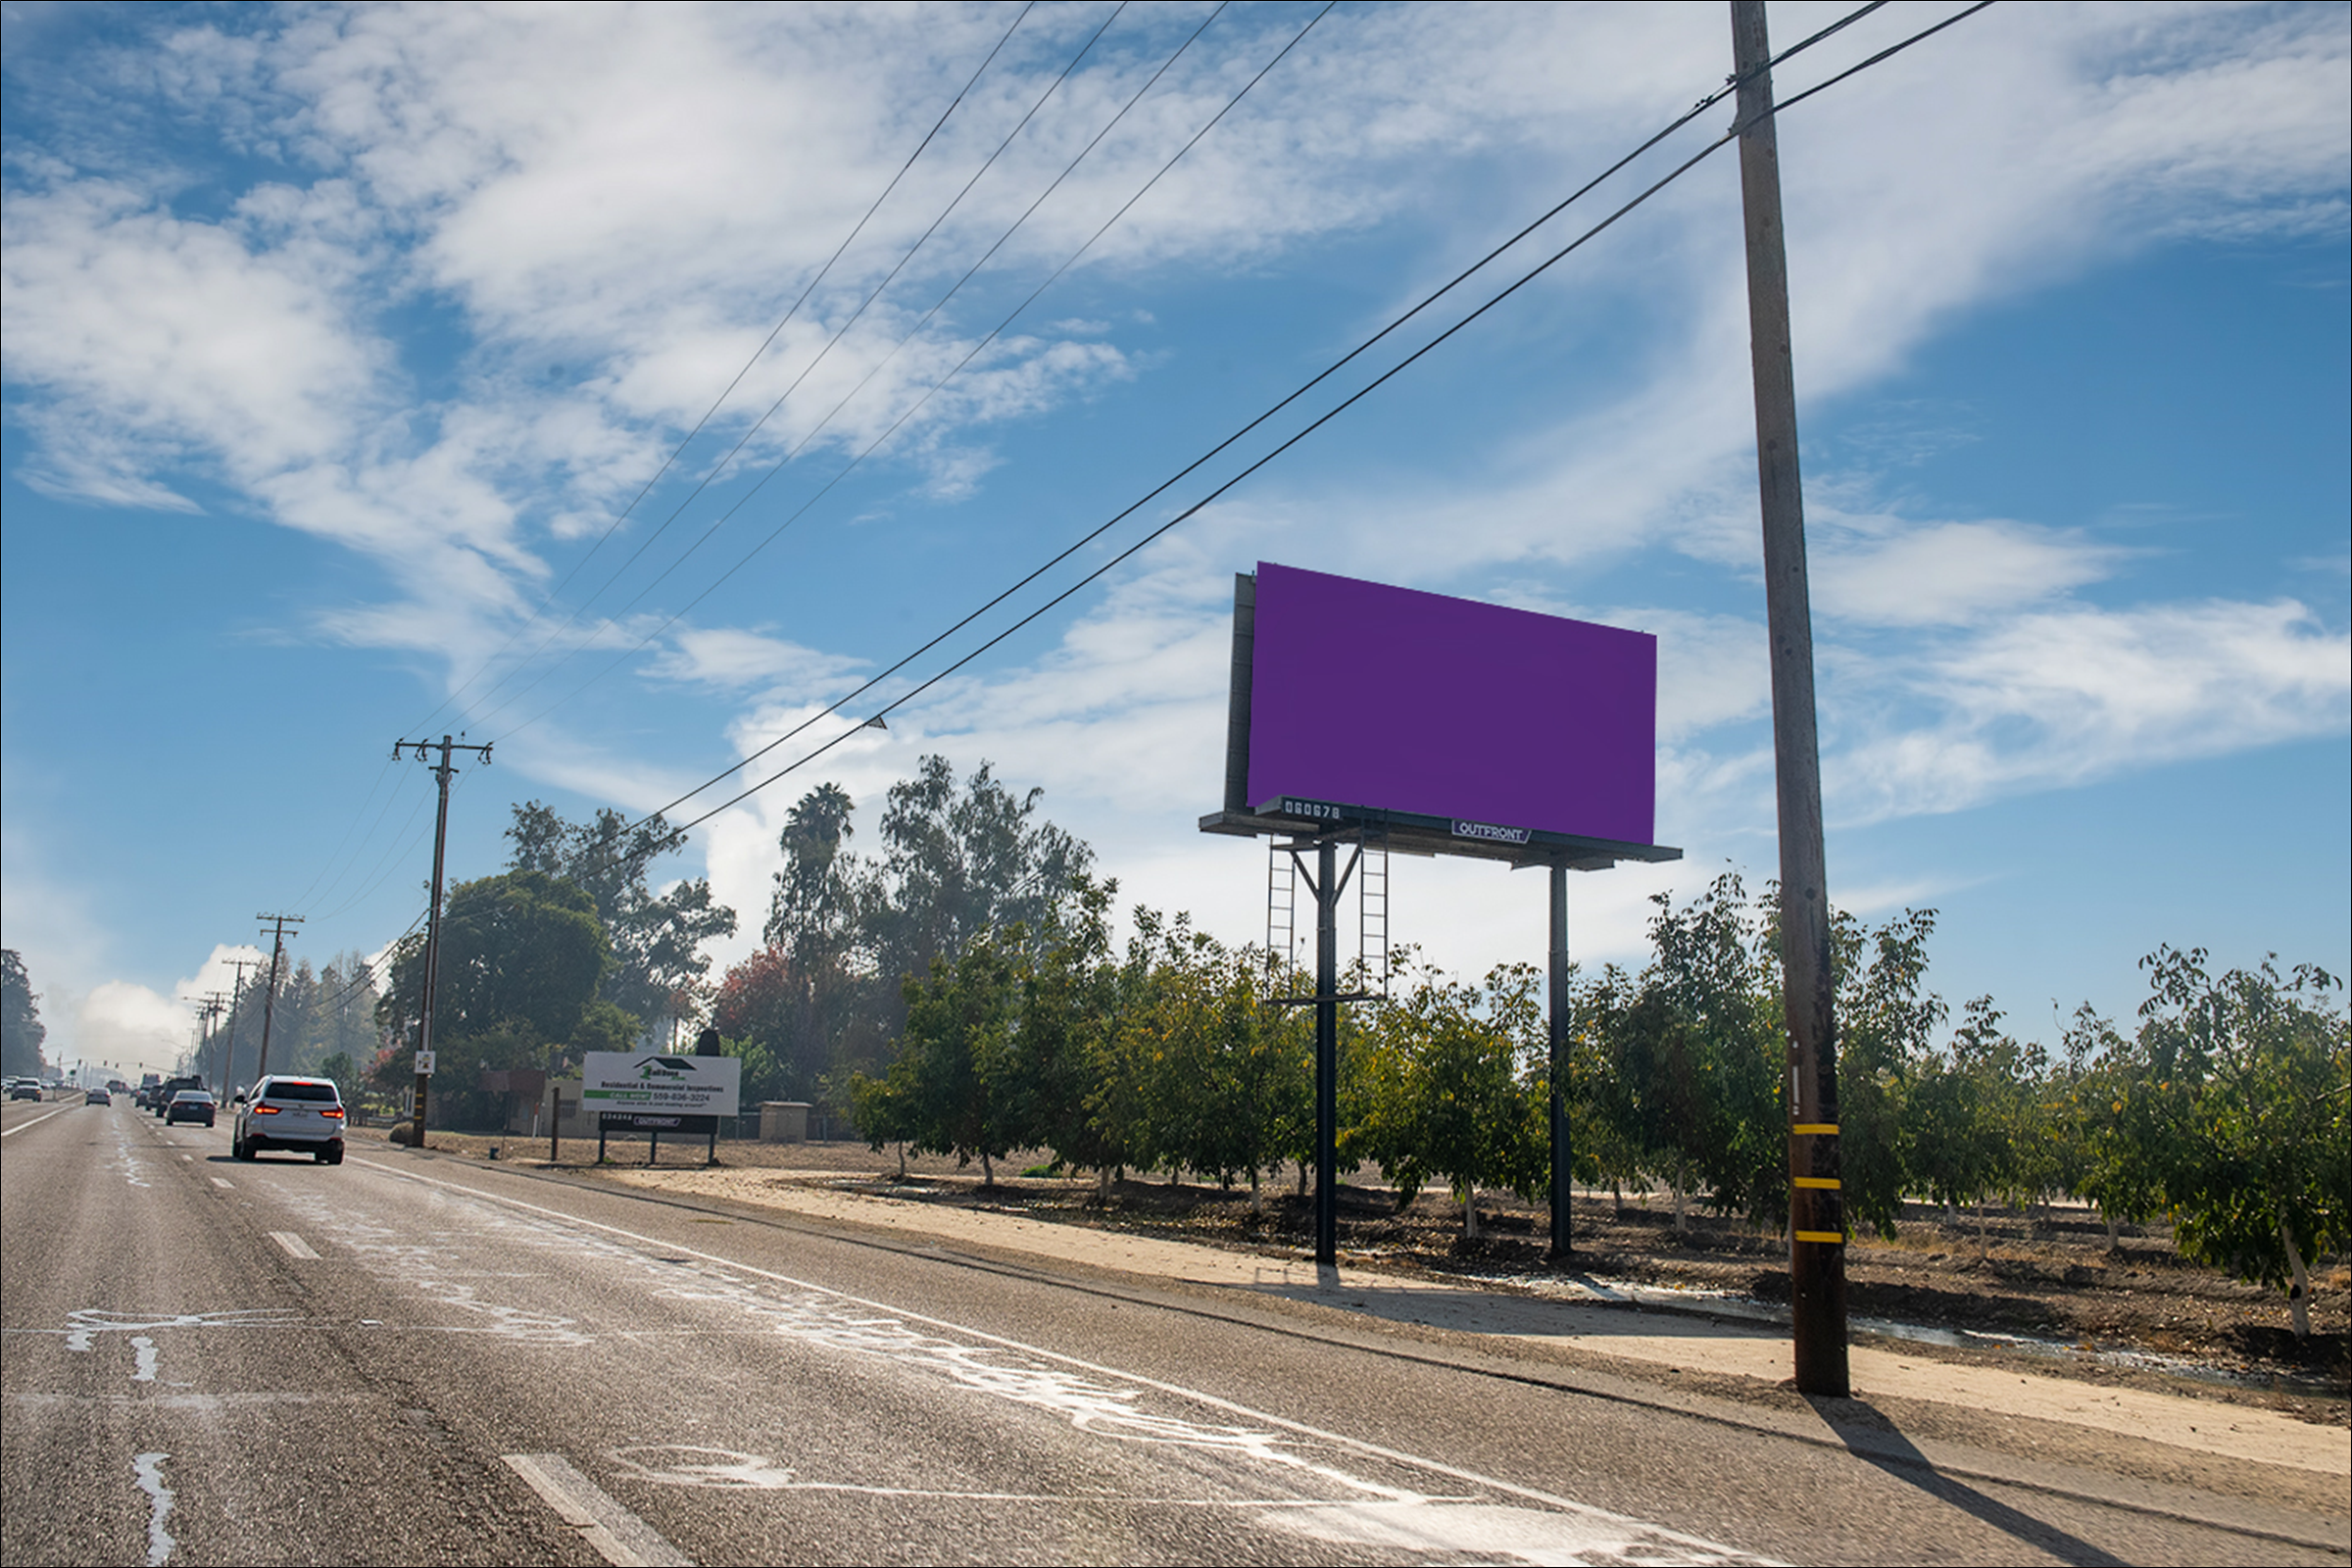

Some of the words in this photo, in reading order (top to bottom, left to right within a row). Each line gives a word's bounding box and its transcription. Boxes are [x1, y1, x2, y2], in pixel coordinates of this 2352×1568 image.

[1285, 800, 1340, 819] 060678
[1459, 822, 1523, 840] OUTFRONT
[647, 1082, 685, 1091] Commercial
[687, 1084, 724, 1093] Inspections
